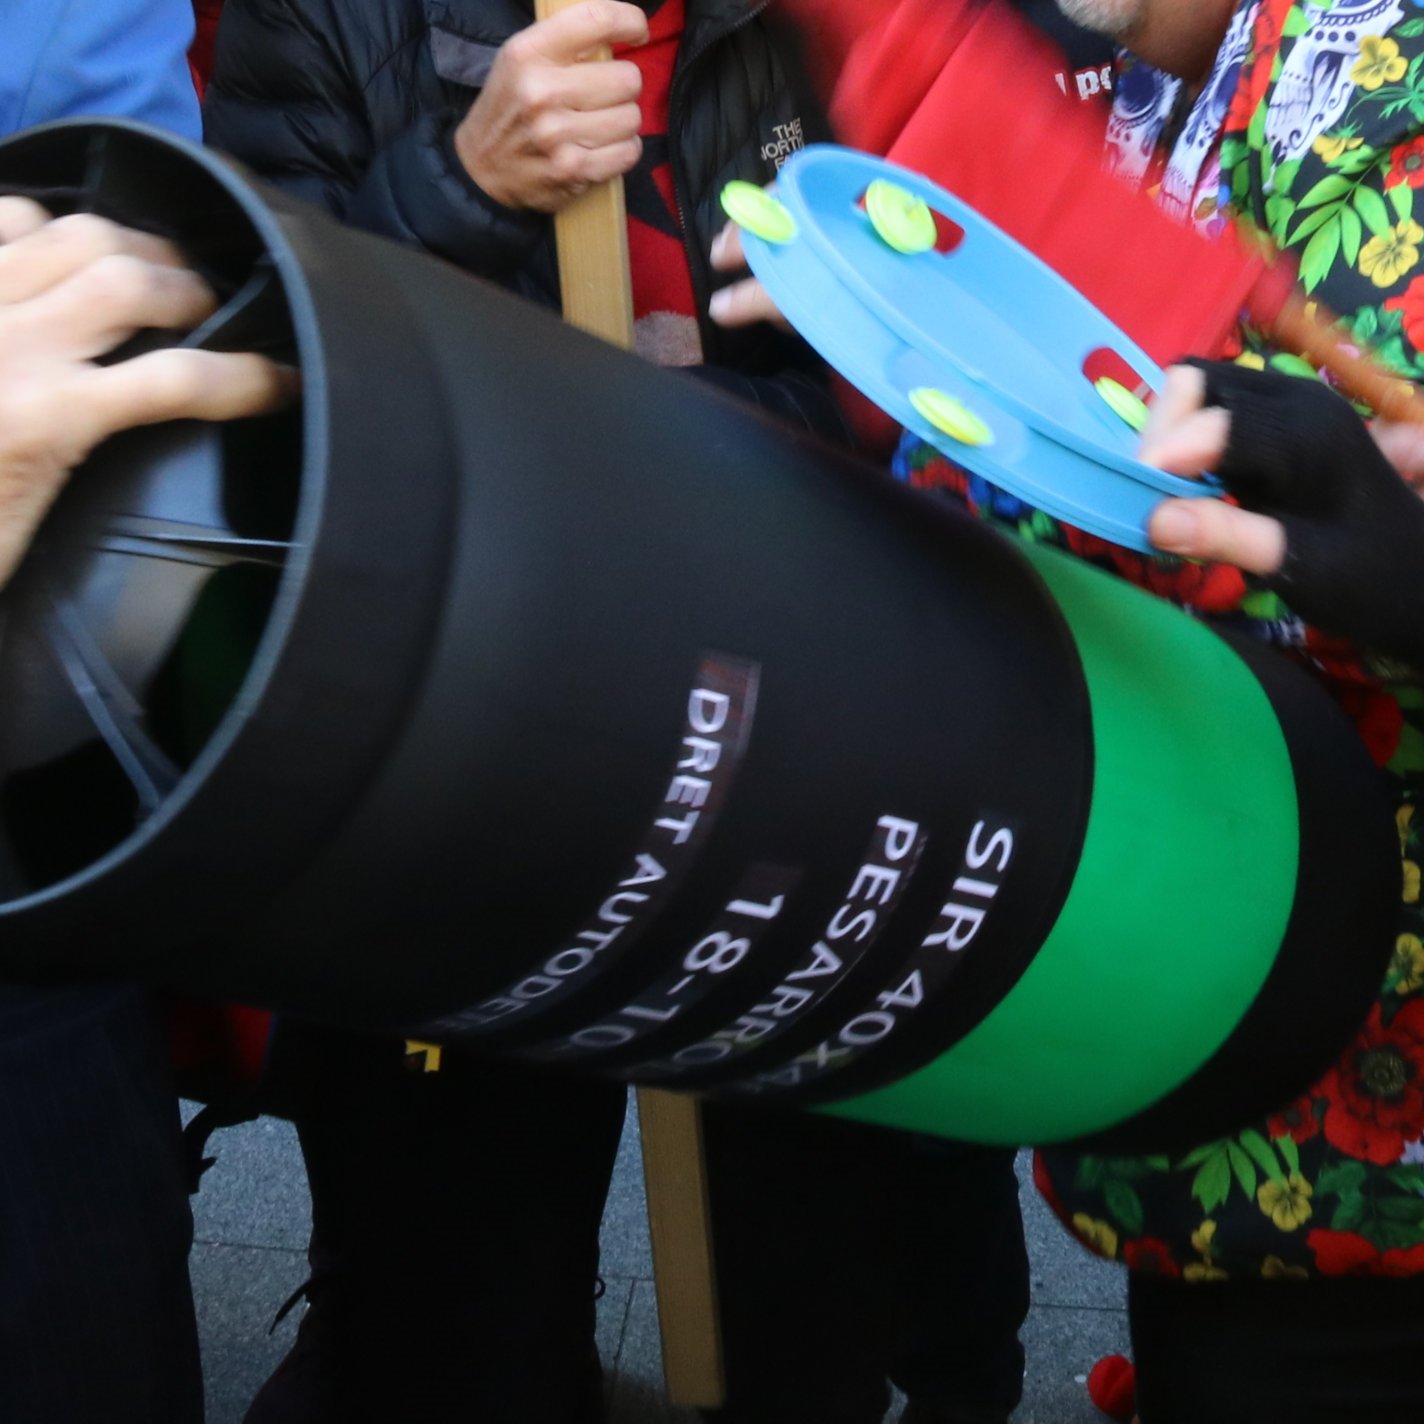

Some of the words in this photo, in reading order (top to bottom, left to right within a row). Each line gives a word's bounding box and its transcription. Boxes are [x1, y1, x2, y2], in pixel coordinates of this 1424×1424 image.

[772, 117, 802, 140] THE
[654, 688, 730, 845] DRET
[921, 819, 1014, 952] SIR
